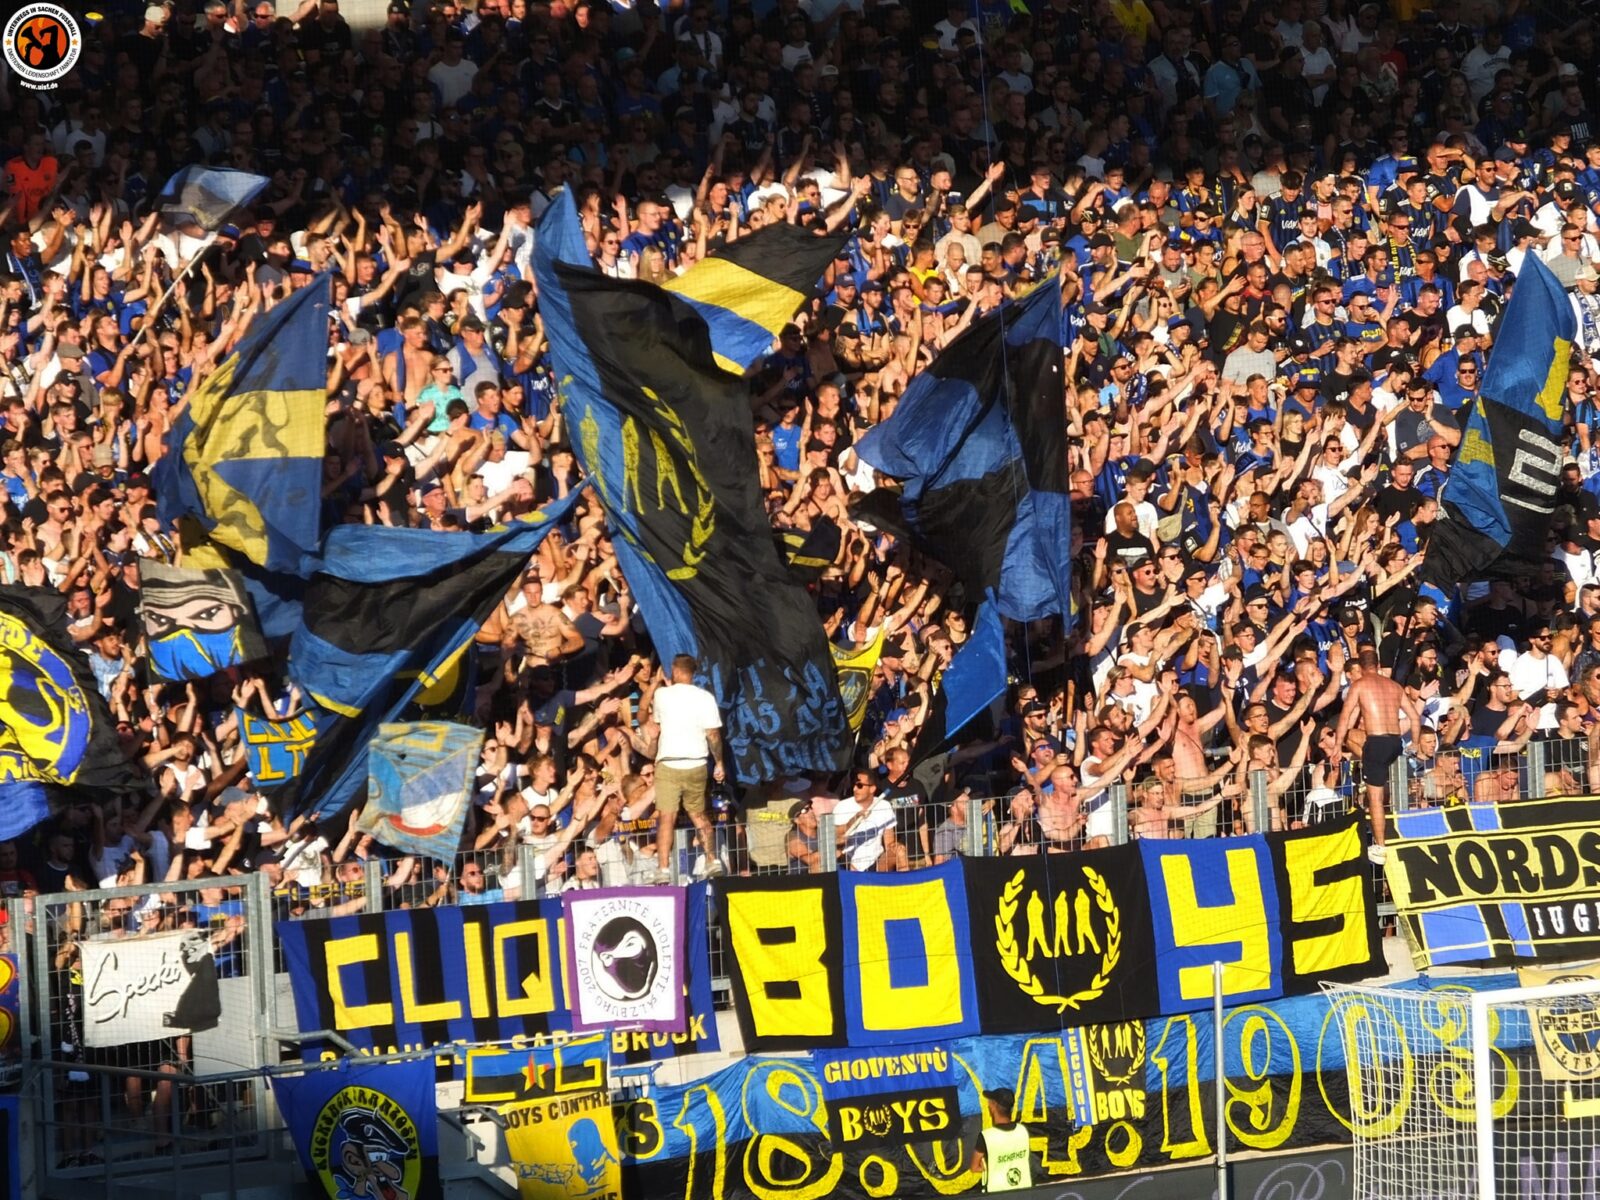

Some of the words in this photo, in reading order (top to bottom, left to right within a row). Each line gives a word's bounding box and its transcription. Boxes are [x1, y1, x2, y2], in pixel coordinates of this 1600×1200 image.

[1532, 902, 1600, 936] JUG
[823, 1046, 948, 1084] GIOVENTÙ
[1096, 1088, 1146, 1122] BOYS
